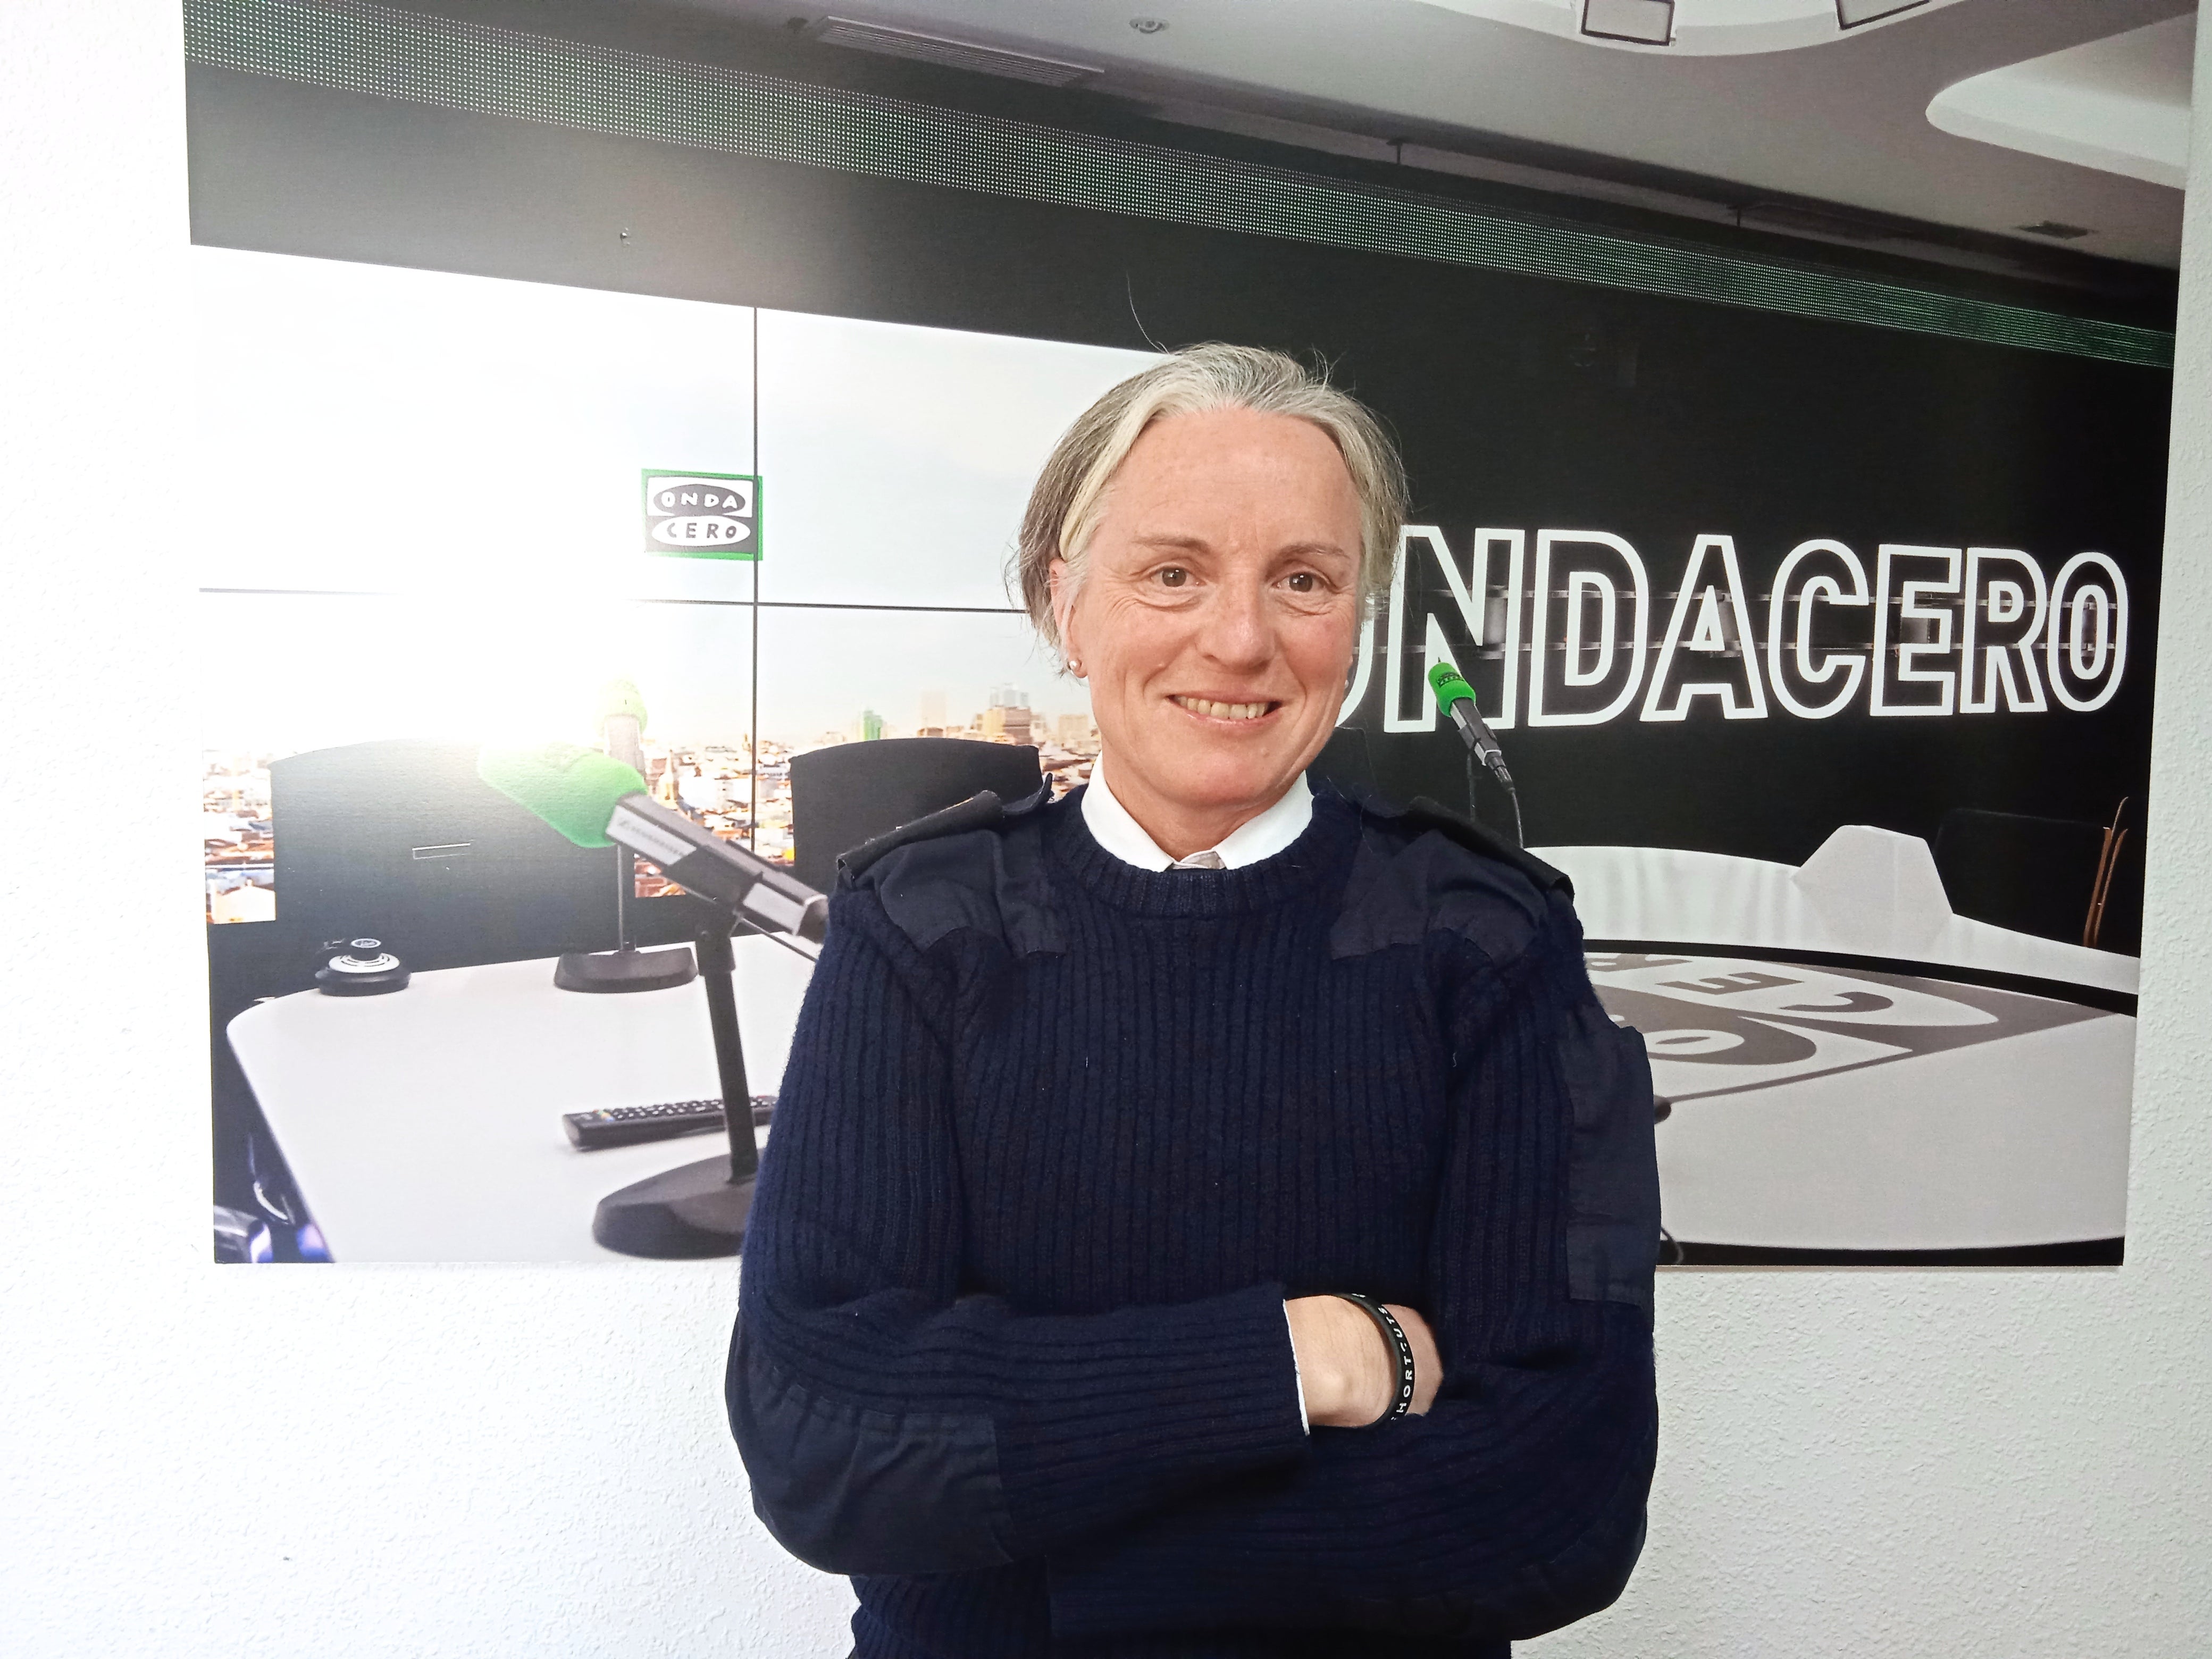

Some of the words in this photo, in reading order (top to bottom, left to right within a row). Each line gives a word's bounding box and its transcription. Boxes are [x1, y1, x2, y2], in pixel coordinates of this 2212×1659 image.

[661, 491, 738, 509] ONDA
[666, 522, 737, 539] CERO
[1334, 524, 2128, 733] NDACERO
[1378, 1307, 1413, 1420] HORTCUTS
